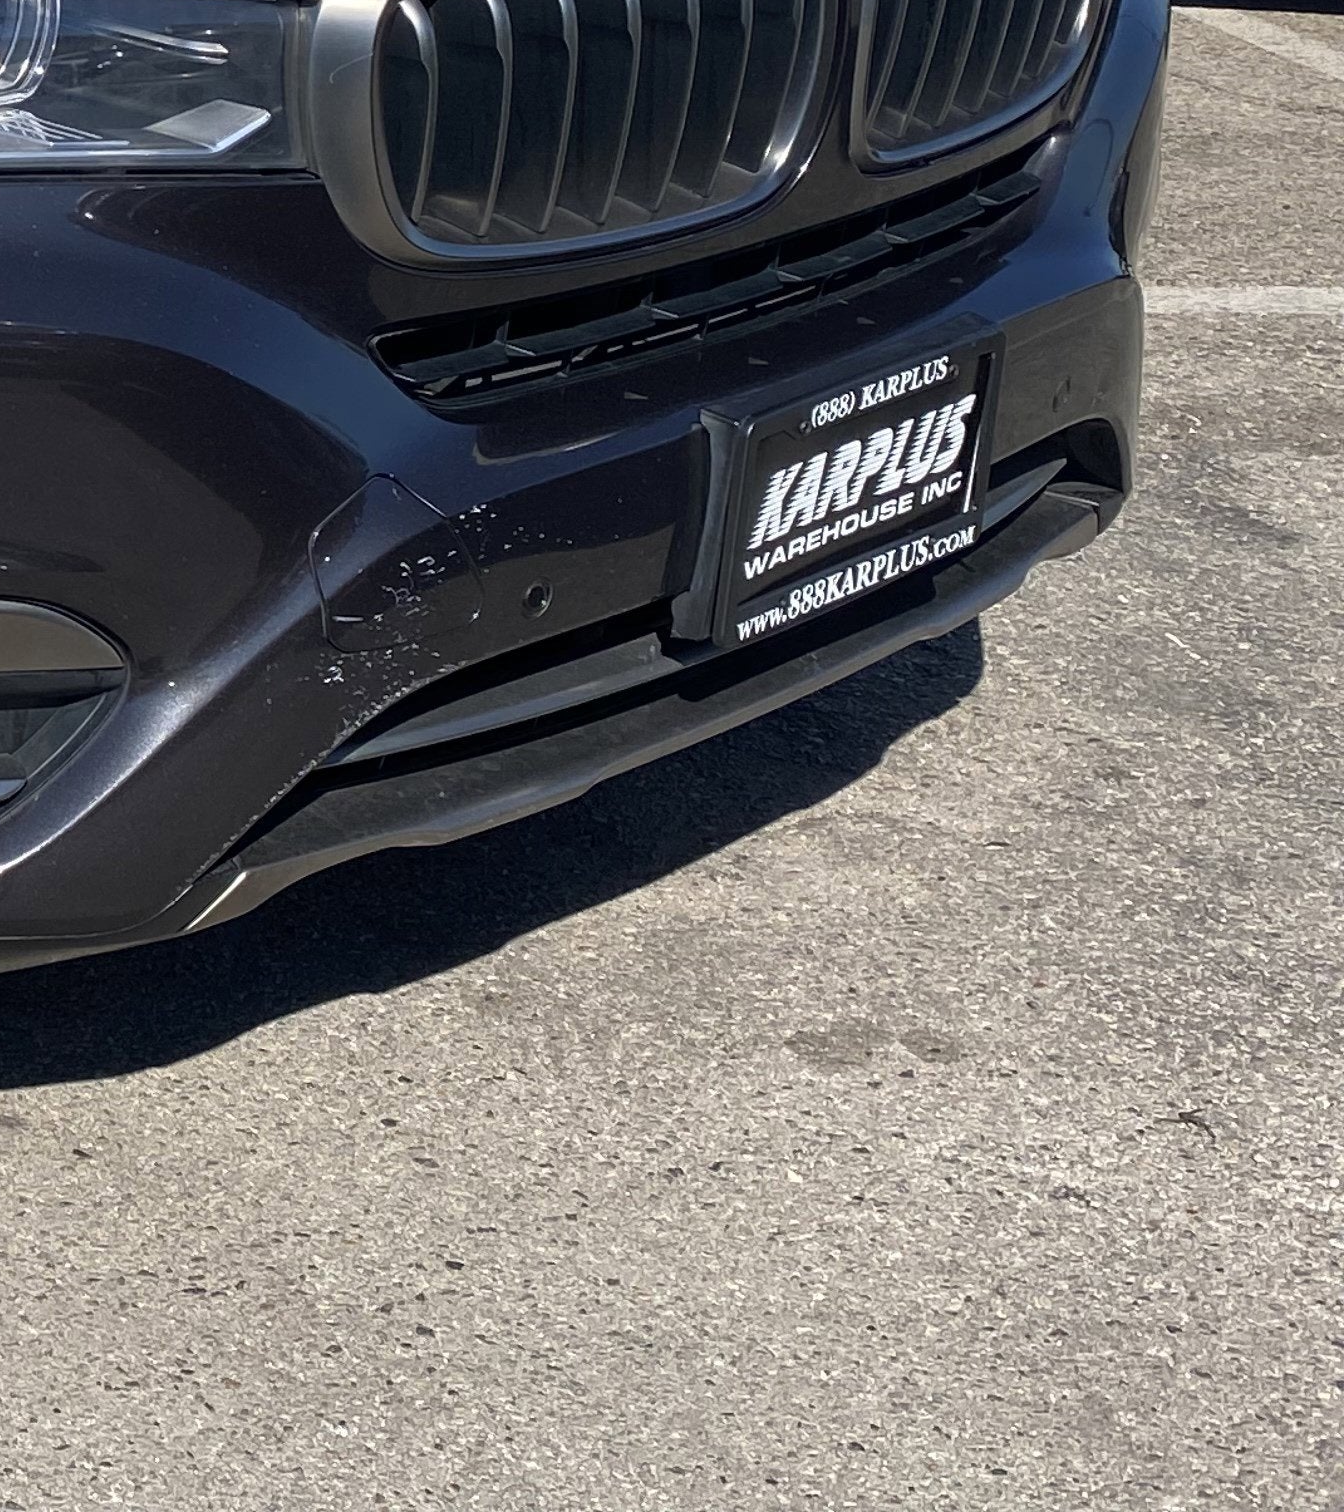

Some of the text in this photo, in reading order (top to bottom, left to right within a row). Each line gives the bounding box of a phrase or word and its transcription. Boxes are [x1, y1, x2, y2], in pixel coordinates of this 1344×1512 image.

[811, 355, 949, 428] (888) KARPLUS
[743, 471, 963, 581] WAREHOUSE INC
[746, 393, 977, 551] KARPLUS
